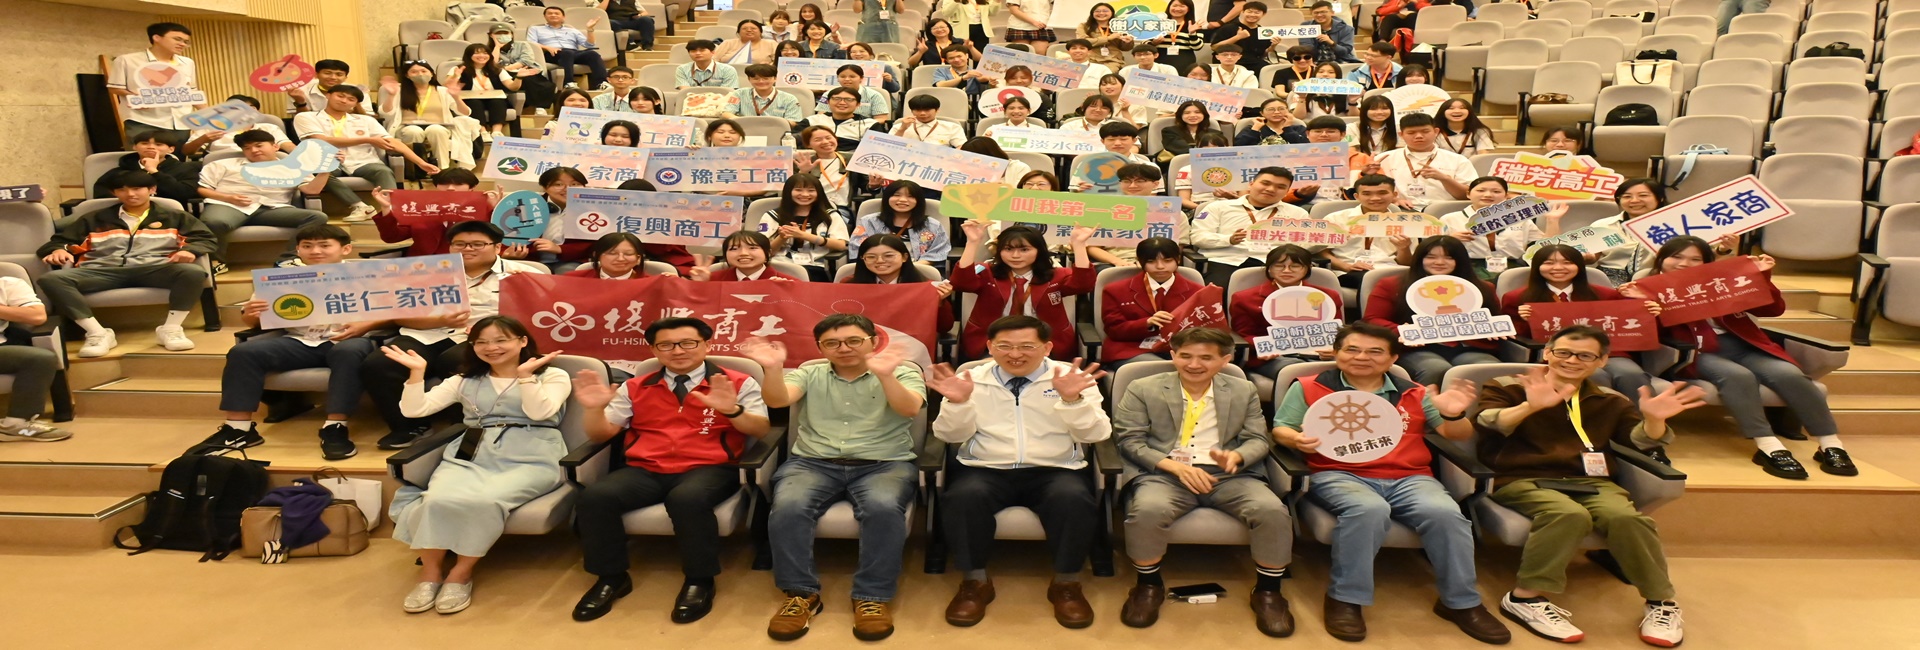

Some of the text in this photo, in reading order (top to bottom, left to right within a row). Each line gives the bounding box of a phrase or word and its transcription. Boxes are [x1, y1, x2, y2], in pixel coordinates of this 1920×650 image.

[1111, 19, 1175, 32] 樹人家商
[1277, 28, 1317, 36] 樹人家商
[806, 73, 877, 87] 三重工
[1029, 139, 1094, 151] 淡水商
[691, 168, 788, 184] 豫章工商
[1240, 164, 1345, 183] 瑞高工
[1499, 161, 1620, 195] 瑞芳高工
[1009, 196, 1137, 221] 叫我第一名
[1479, 198, 1526, 218] 樹人家商
[1271, 218, 1327, 229] 樹人家商
[1368, 214, 1423, 222] 樹人家商
[1470, 201, 1549, 235] 餐飲管理科
[1646, 189, 1771, 246] 樹人家商
[616, 215, 731, 239] 復興商工
[1250, 229, 1345, 244] 觀光事業科
[1657, 275, 1753, 304] 復興商工
[1733, 287, 1759, 296] SCHOOL
[323, 284, 462, 315] 能仁家商
[1417, 311, 1489, 327] 首創市級
[1271, 322, 1339, 340] 解析技職
[1404, 321, 1511, 341] 學習歷程競賽
[709, 343, 730, 352] RTS
[1333, 435, 1394, 457] 掌舵未來
